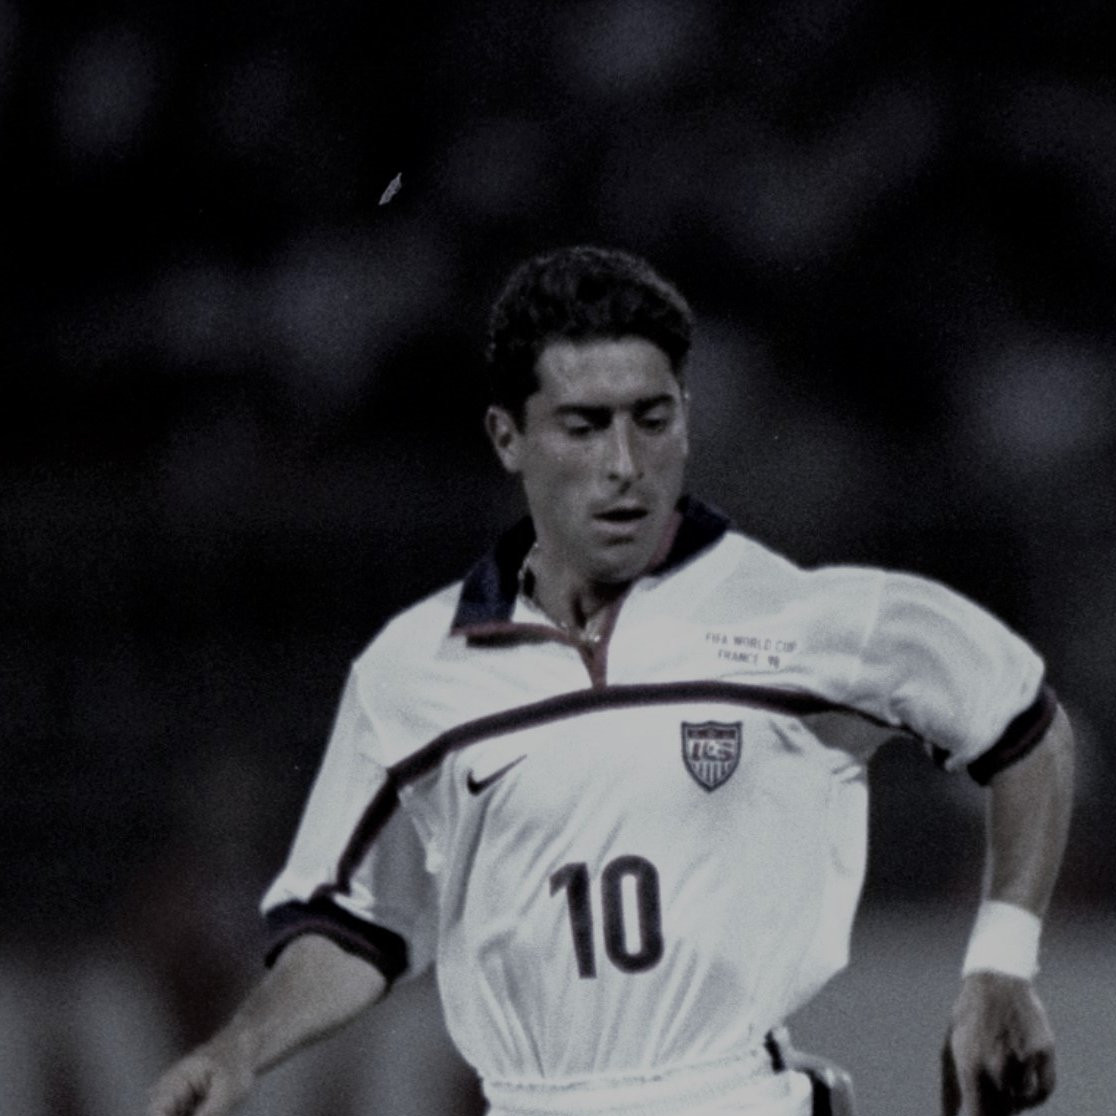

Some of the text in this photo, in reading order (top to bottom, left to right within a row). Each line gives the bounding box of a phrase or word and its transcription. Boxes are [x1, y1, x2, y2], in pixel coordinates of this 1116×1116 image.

[733, 635, 772, 651] WORLD
[775, 640, 797, 653] CUP
[549, 853, 665, 979] 10
